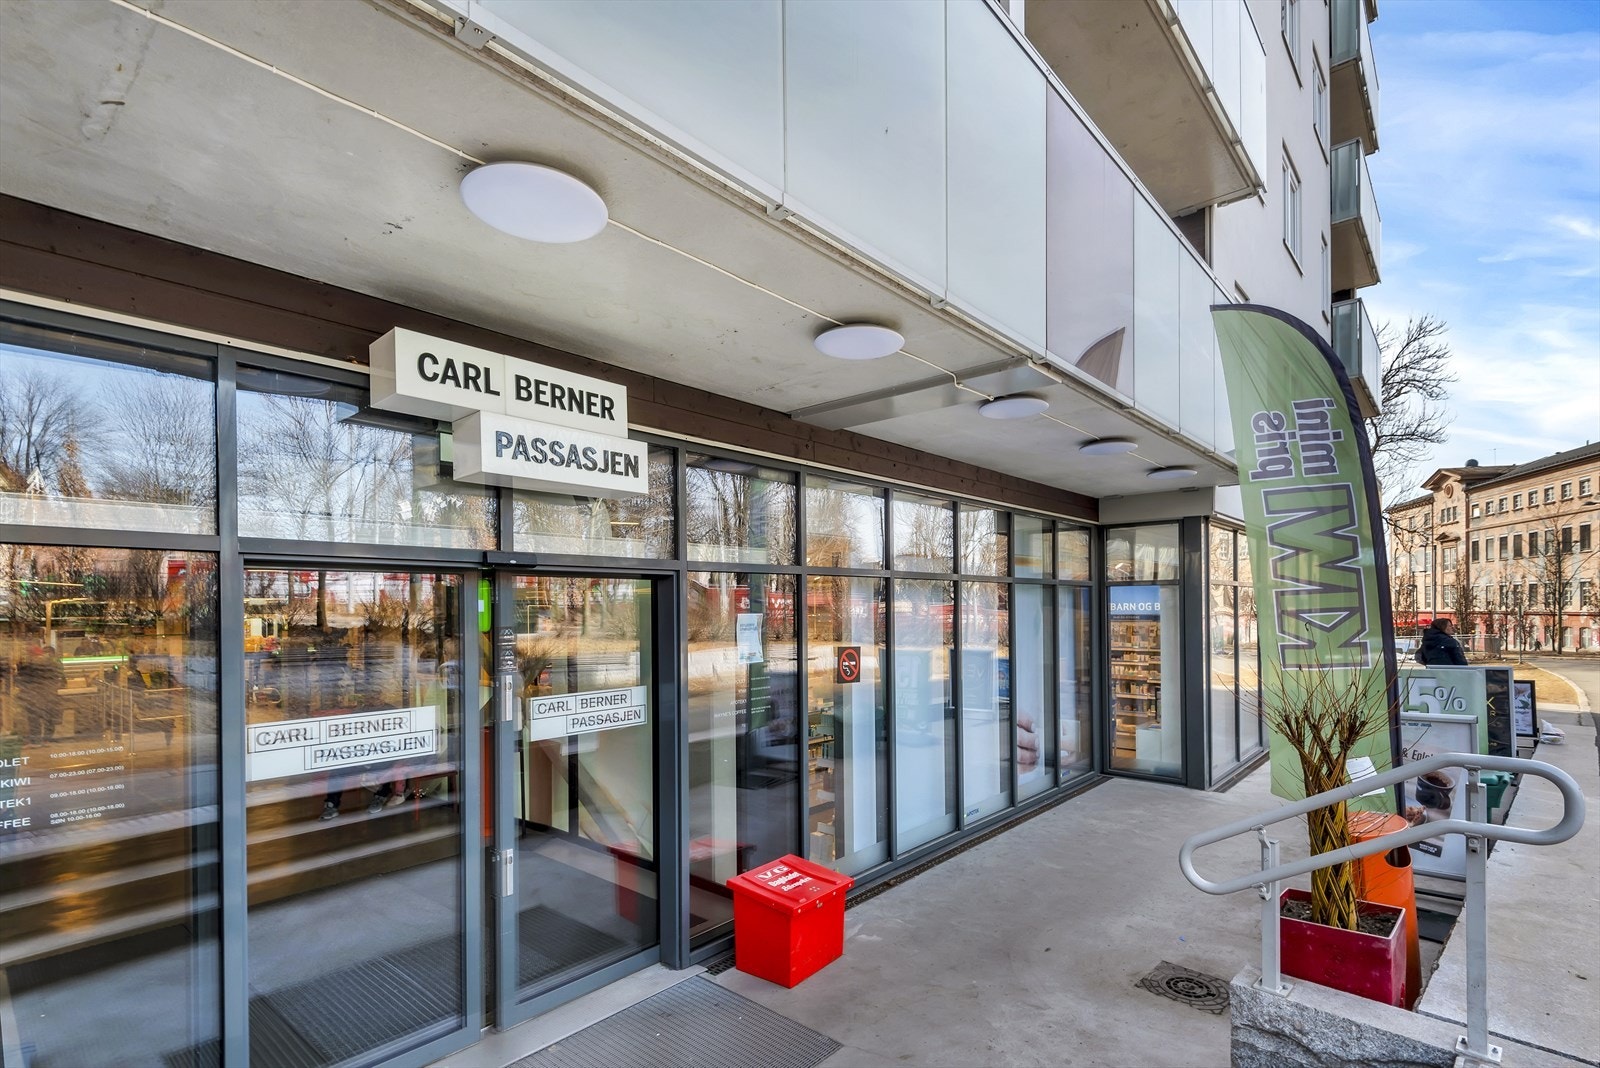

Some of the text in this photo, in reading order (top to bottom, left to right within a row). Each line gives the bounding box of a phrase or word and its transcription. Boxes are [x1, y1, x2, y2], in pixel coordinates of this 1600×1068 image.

[417, 352, 615, 421] CARL BERNER
[495, 430, 640, 478] PASSASJEN
[1110, 602, 1136, 611] BARN
[1138, 602, 1152, 611] OG
[537, 693, 628, 715] CARL BERNER
[572, 709, 641, 729] PASSASJEN
[256, 716, 406, 746] CARL BERNER
[314, 735, 430, 764] PASSASJEN
[1, 777, 31, 788] KIWI
[757, 865, 790, 879] VG
